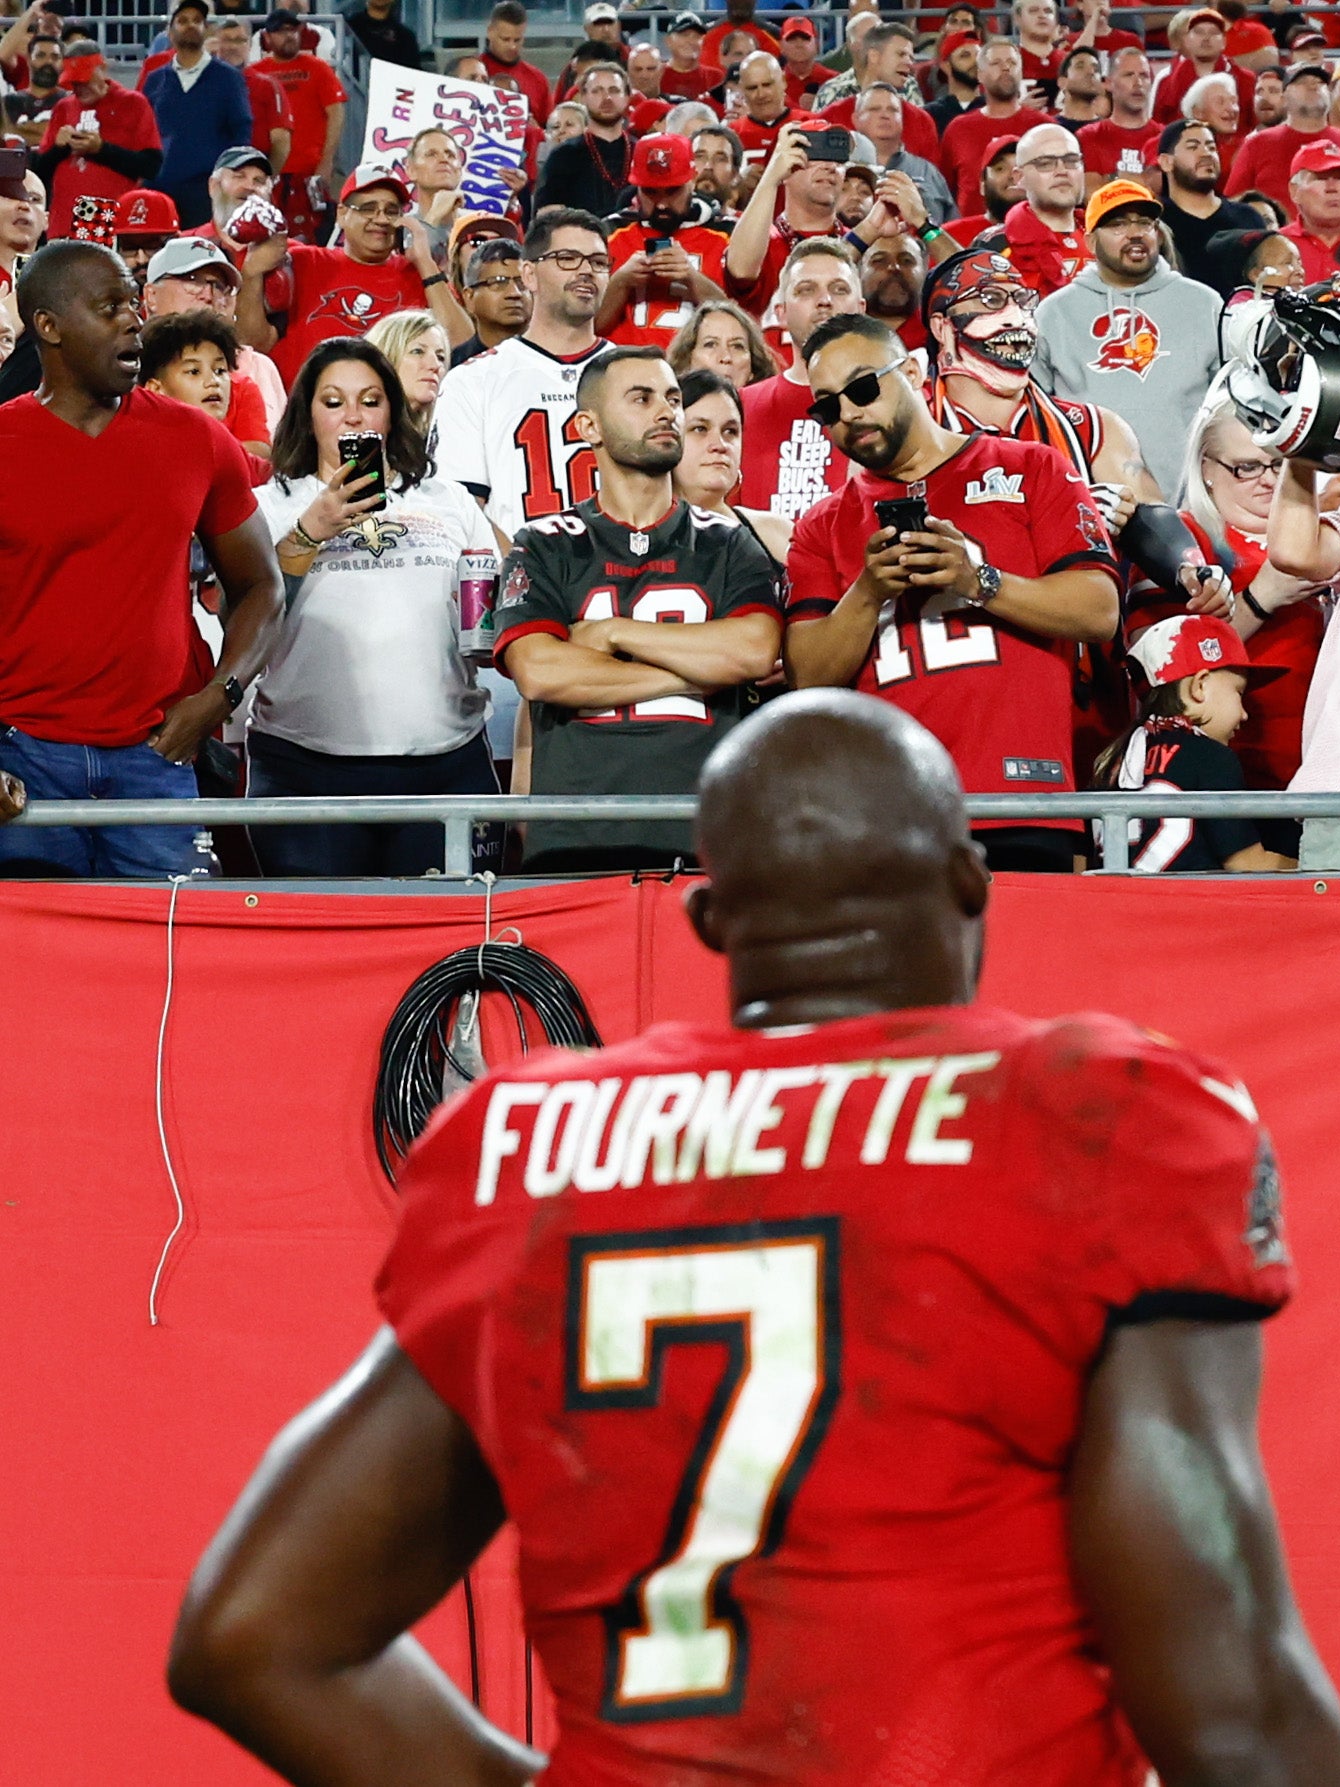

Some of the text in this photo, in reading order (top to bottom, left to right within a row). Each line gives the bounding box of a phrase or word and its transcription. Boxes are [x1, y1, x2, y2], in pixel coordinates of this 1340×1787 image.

[494, 89, 528, 141] HOT
[460, 131, 524, 215] BRADY
[541, 392, 577, 403] BUCCAN
[778, 440, 832, 468] SLEEP.
[778, 466, 829, 494] BUCS.
[466, 558, 497, 570] VIZZ
[475, 1049, 1001, 1207] FOURNETTE
[564, 1215, 842, 1725] 7
